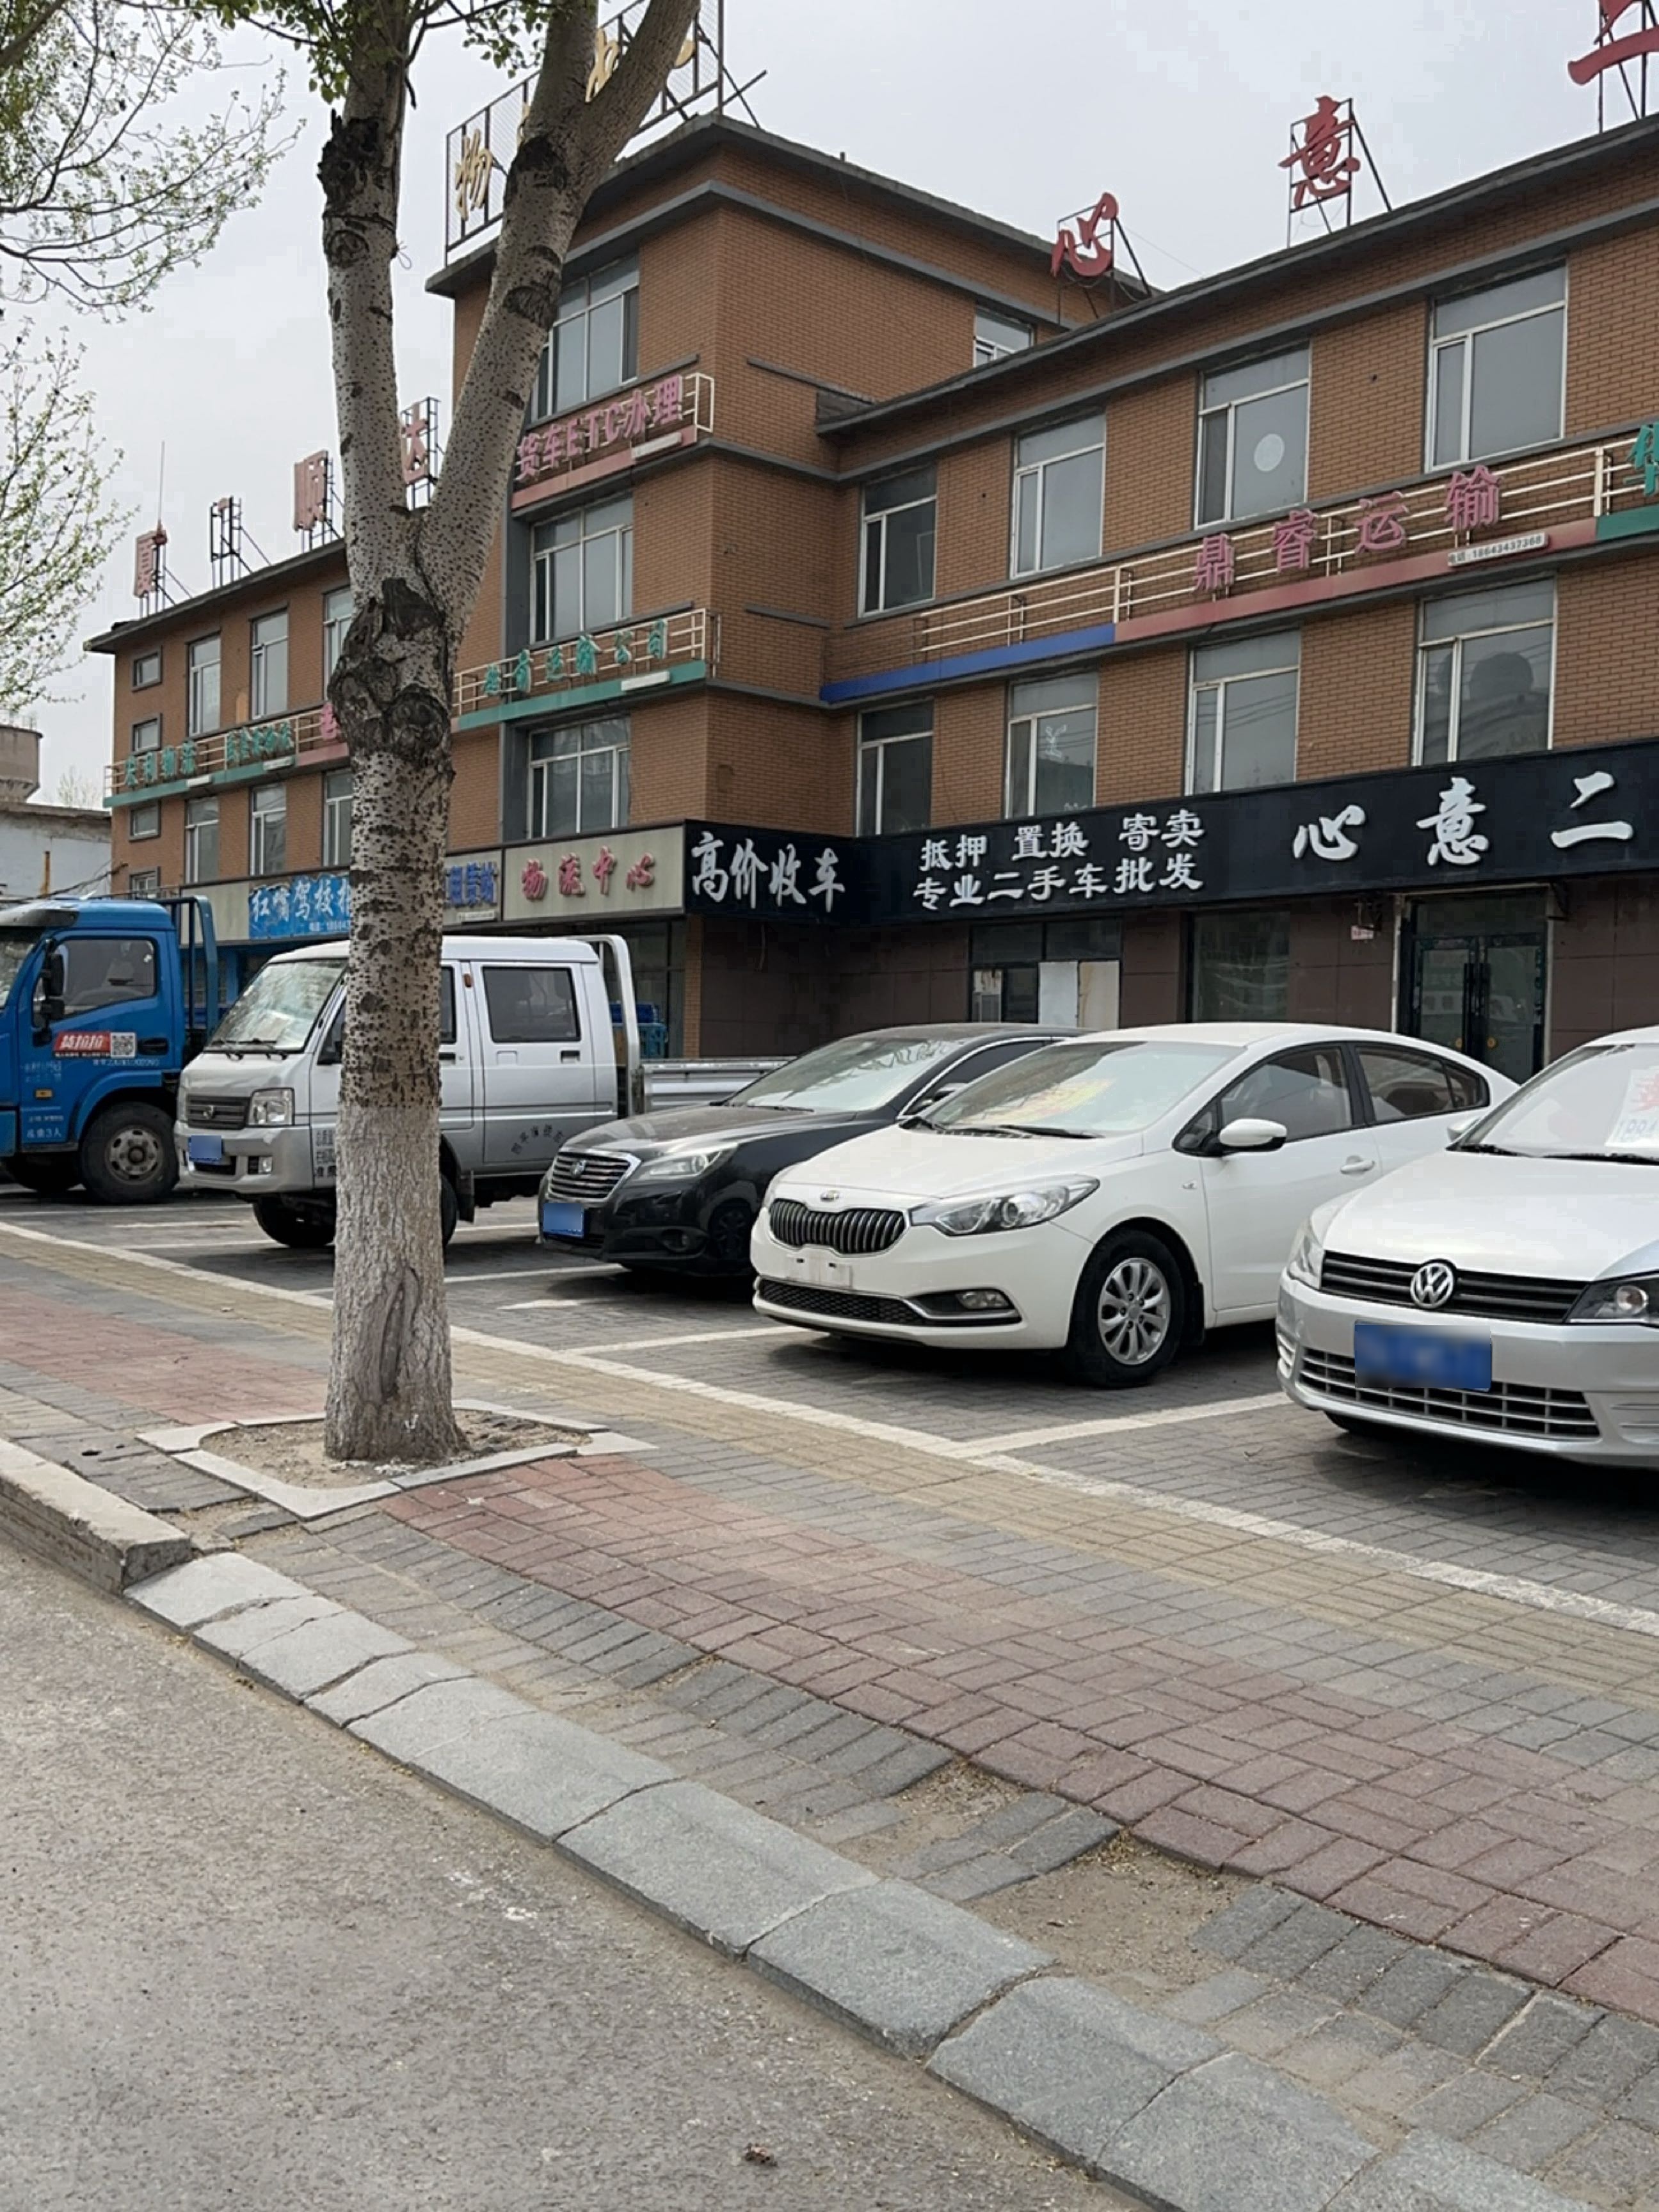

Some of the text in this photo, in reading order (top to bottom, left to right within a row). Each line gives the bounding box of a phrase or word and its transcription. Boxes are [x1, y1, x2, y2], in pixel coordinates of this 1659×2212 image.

[515, 374, 684, 481] 货车ETC办理
[1193, 464, 1503, 593] 鼎睿运输
[919, 809, 1205, 872] 抵押 置换 寄卖
[1293, 771, 1633, 865] 心意二
[522, 846, 655, 901] 物流中心
[691, 831, 846, 913] 高价收车
[913, 853, 1204, 910] 专业二手车批发
